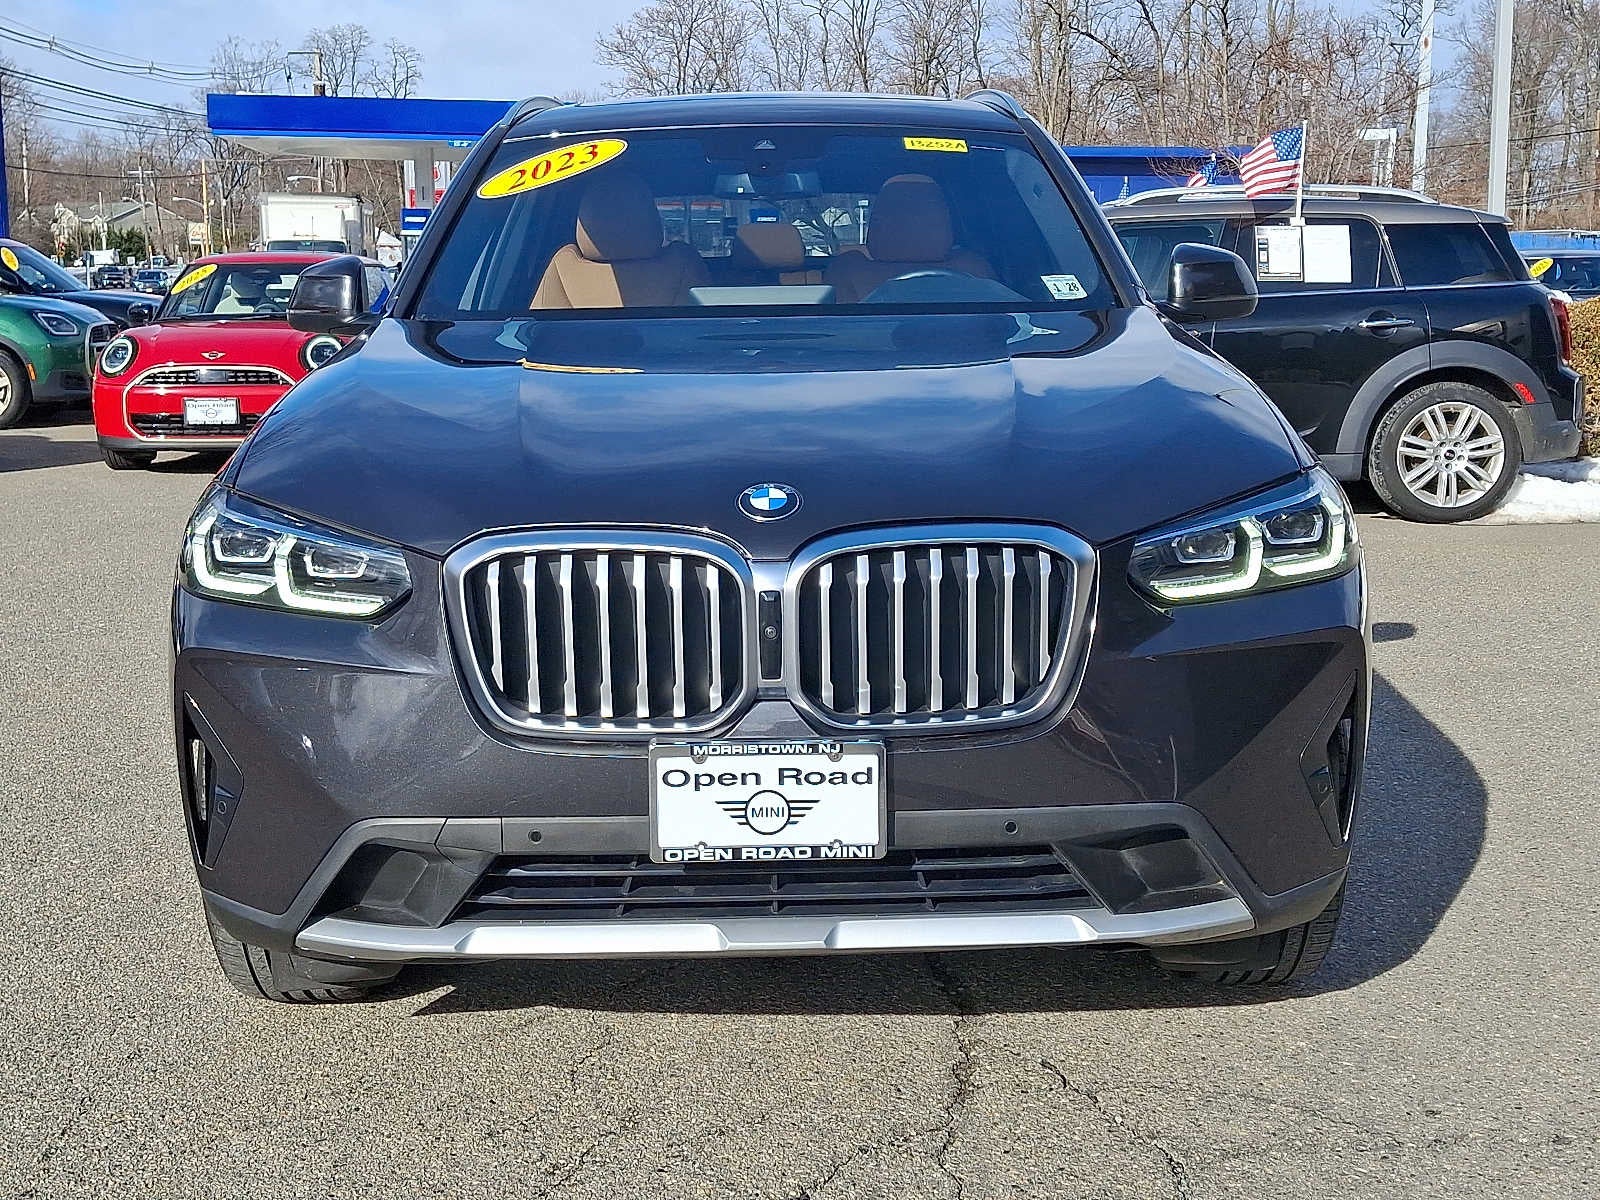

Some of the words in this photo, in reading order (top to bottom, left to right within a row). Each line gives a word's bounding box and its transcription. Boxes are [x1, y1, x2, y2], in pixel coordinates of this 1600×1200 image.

[508, 144, 599, 191] 2023
[1065, 282, 1080, 292] 28
[693, 744, 813, 756] MORRISTOWN,
[818, 743, 841, 754] NJ
[662, 769, 762, 791] Open
[778, 767, 873, 786] Road
[751, 806, 786, 819] MINI
[664, 848, 733, 862] OPEN
[741, 847, 812, 860] ROAD
[820, 845, 874, 859] MINI
